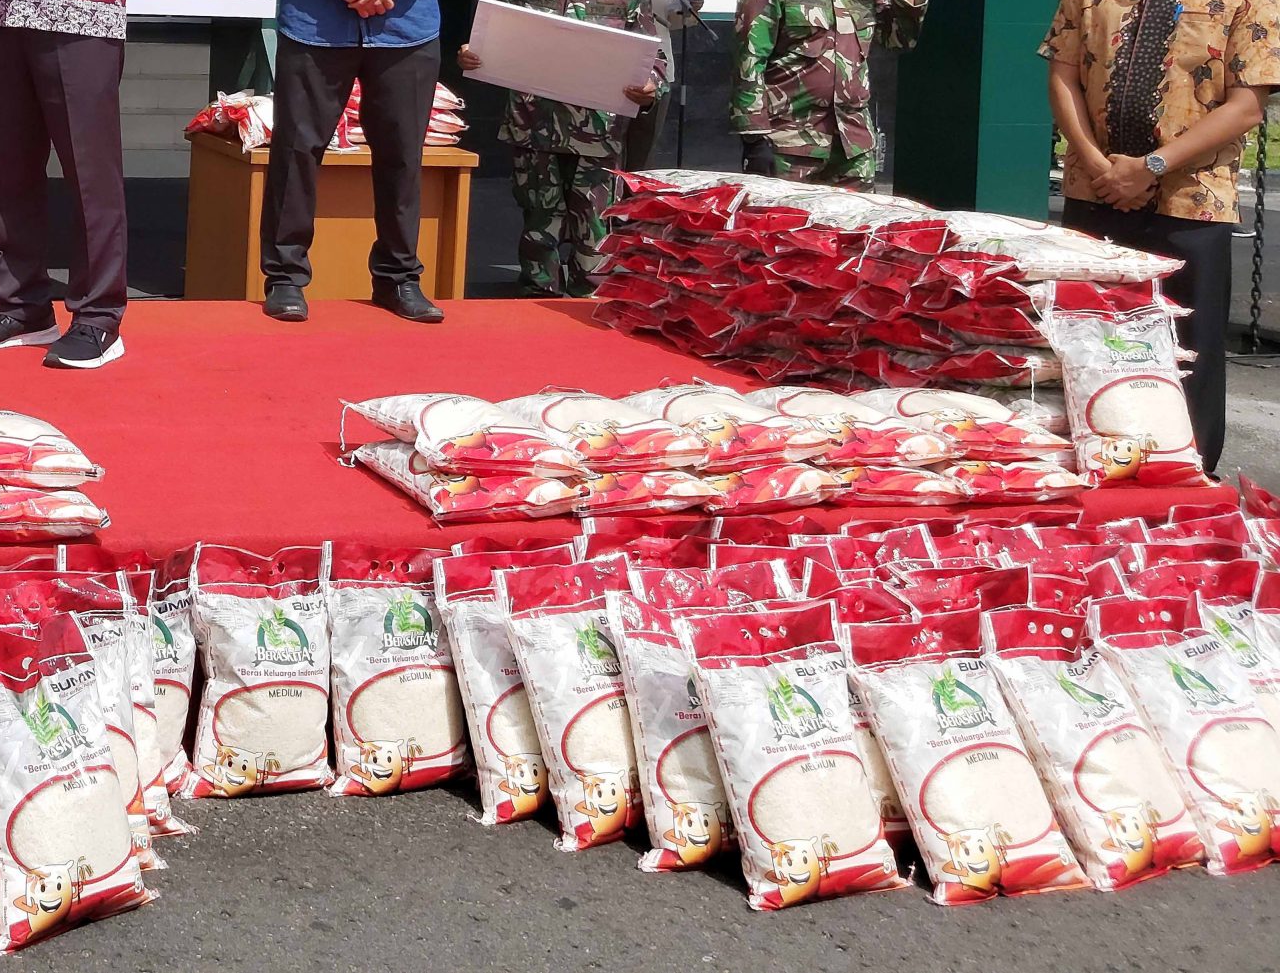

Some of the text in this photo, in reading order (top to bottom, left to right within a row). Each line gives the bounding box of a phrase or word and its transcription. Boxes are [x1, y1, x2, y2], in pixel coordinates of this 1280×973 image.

[154, 594, 193, 615] UMN
[399, 671, 433, 683] MEDIUM
[268, 688, 303, 698] MEDIUM
[965, 751, 999, 765] MEDIUM
